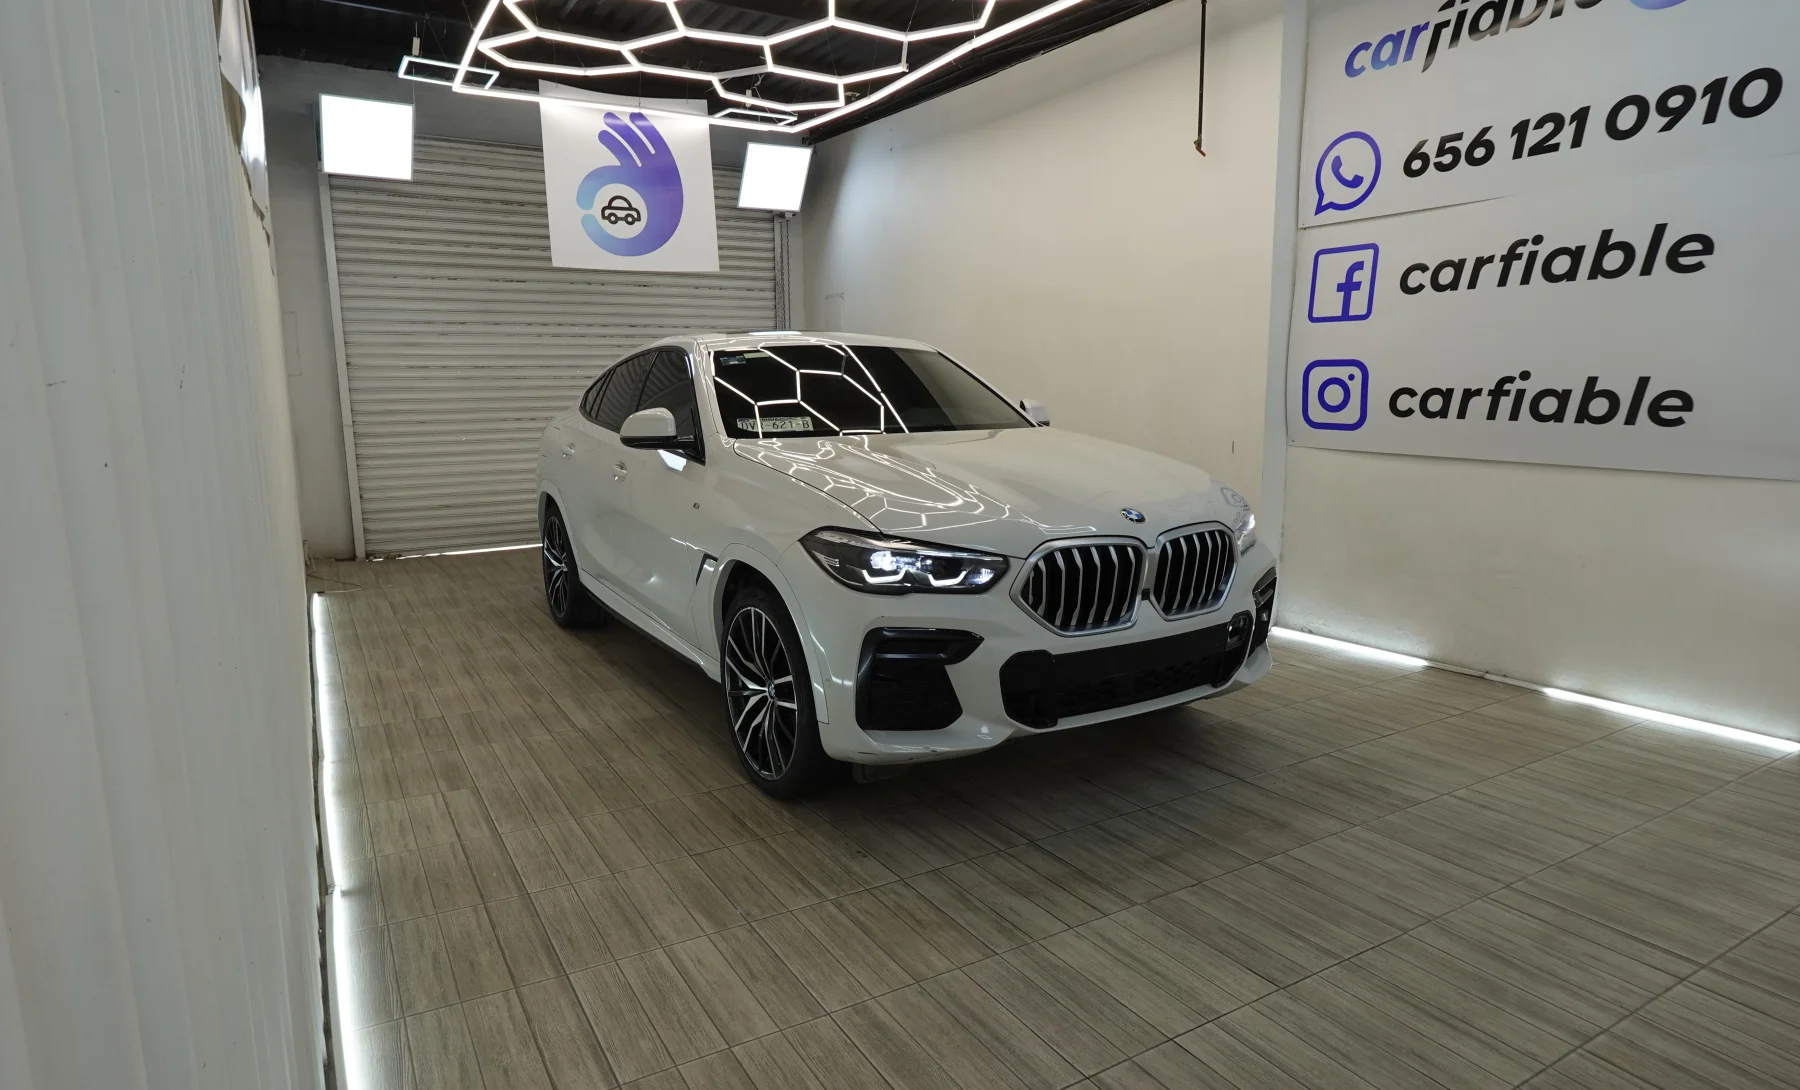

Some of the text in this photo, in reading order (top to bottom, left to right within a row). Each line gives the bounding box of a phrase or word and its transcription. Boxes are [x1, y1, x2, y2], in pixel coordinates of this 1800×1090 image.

[1402, 67, 1784, 179] 656 121 0910
[1399, 222, 1715, 296] carfiable
[1388, 369, 1695, 428] carfiable
